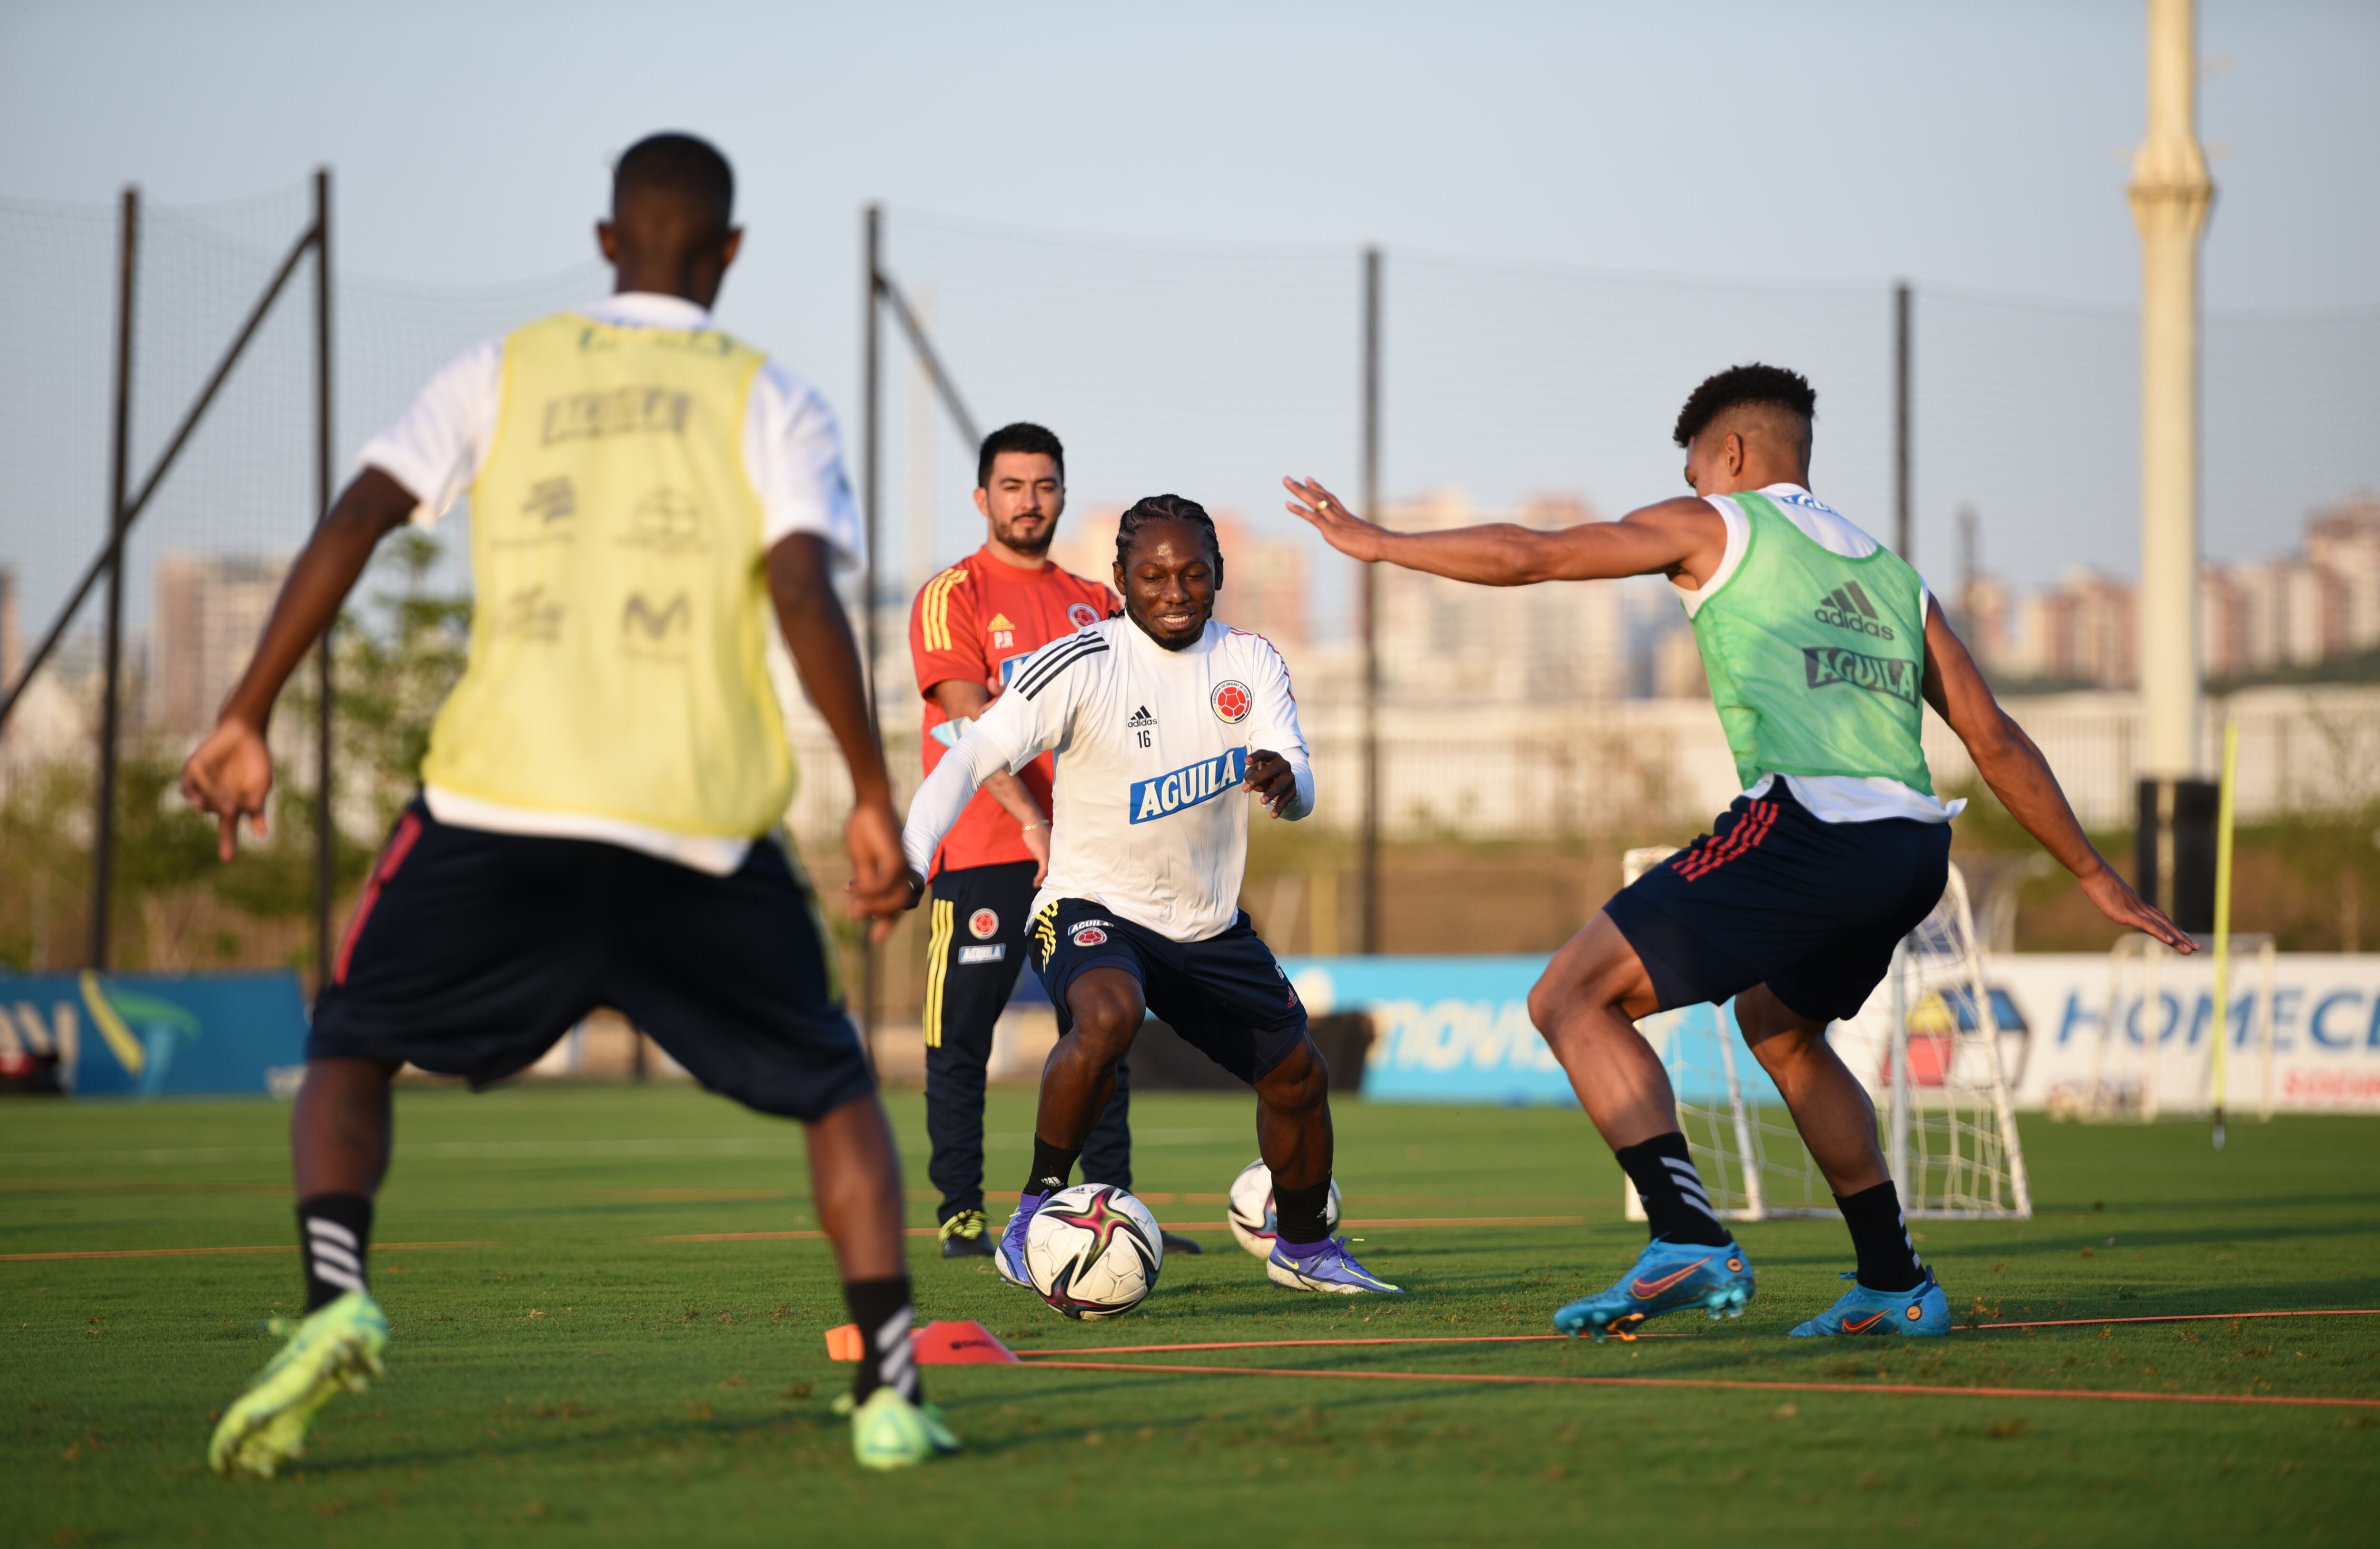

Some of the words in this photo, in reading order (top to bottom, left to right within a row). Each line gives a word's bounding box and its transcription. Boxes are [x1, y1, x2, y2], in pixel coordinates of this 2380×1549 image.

[1814, 609, 1894, 641] adidas
[1815, 651, 1915, 701] AGUILA
[1128, 718, 1158, 728] adidas
[1137, 730, 1151, 749] 16
[1136, 750, 1237, 820] AGUILA
[1071, 920, 1109, 933] AGUILA
